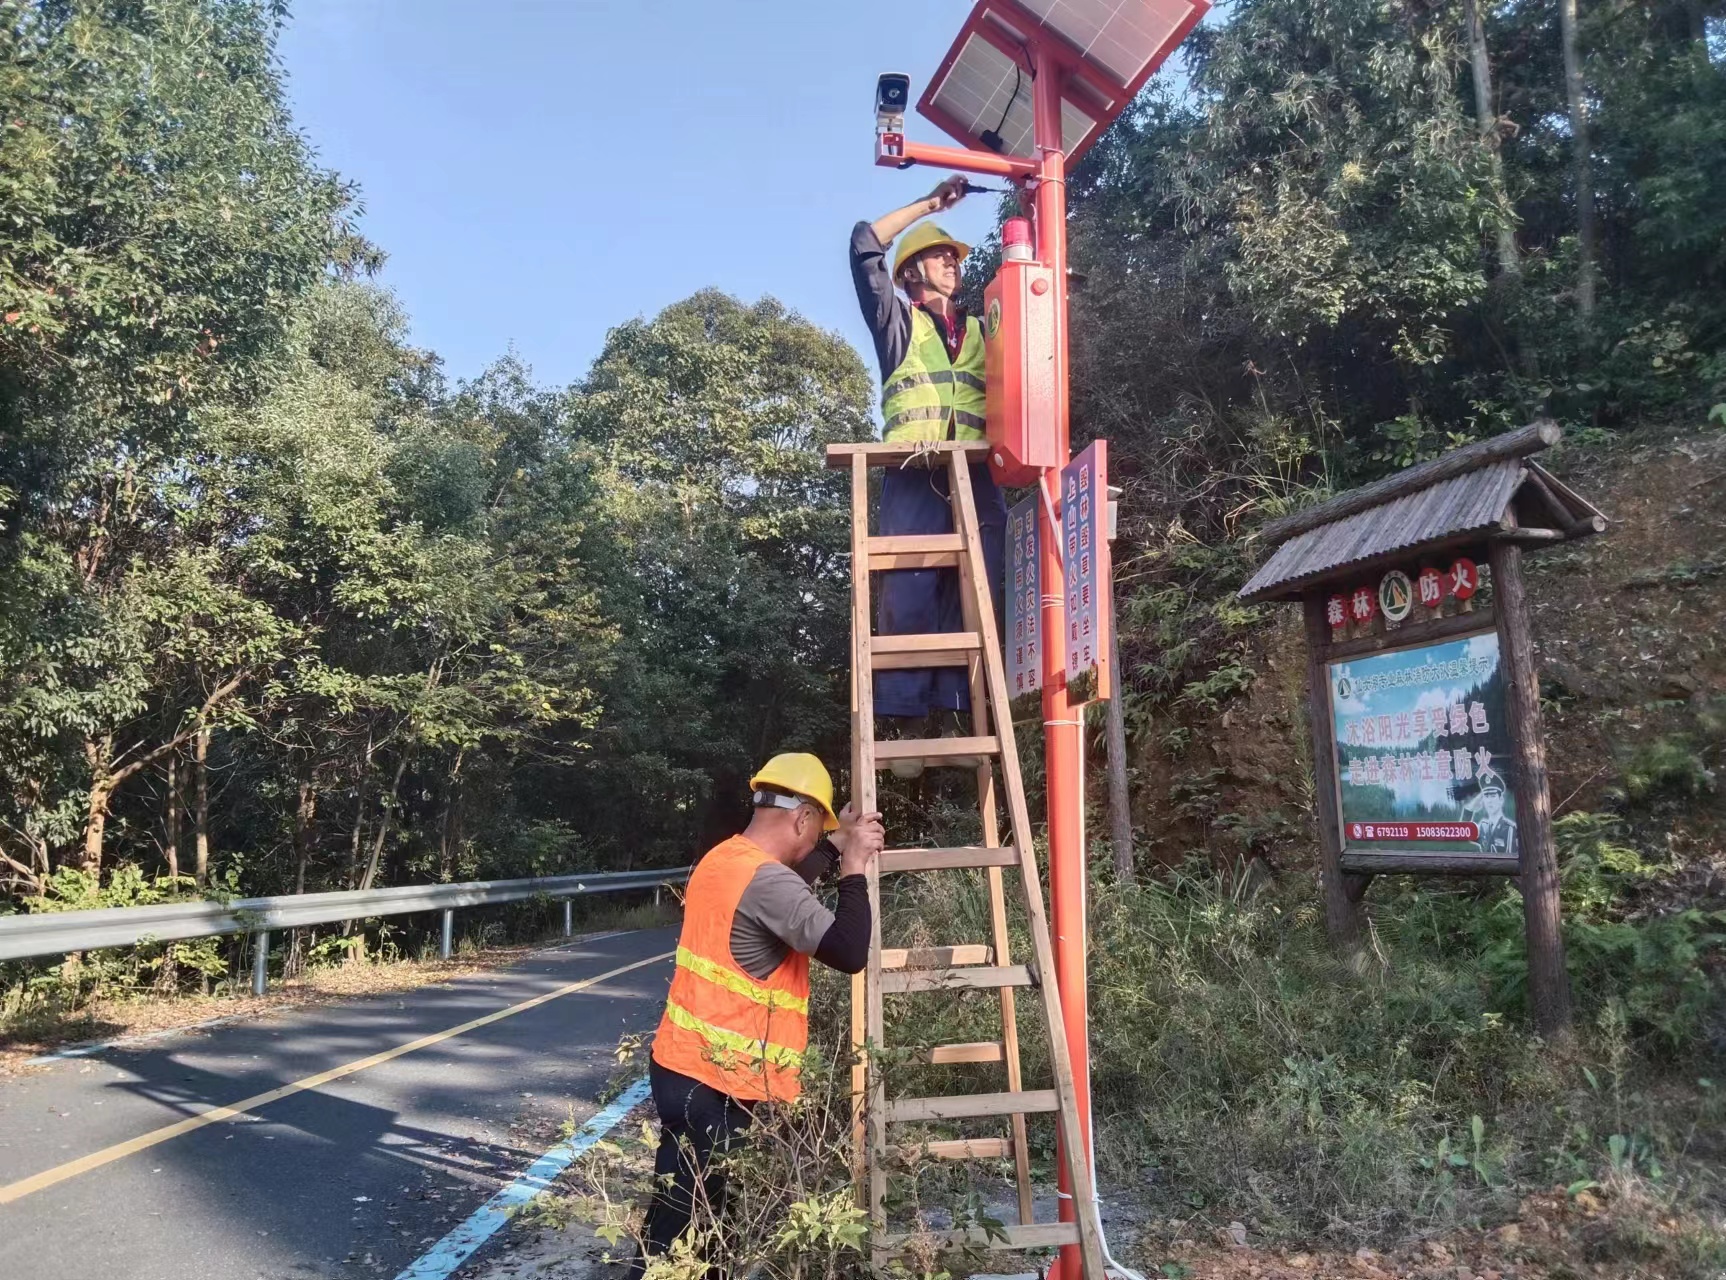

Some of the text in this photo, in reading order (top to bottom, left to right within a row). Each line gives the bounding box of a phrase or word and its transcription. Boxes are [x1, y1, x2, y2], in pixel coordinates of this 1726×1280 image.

[1015, 517, 1024, 691] 野外用火须谨慎
[1026, 508, 1036, 687] 引发火灾法不容
[1327, 591, 1370, 624] 森林
[1419, 563, 1472, 602] 防火
[1345, 701, 1490, 745] 沐浴阳光享受绿色
[1348, 746, 1496, 786] 走进森林注意防火
[1376, 826, 1471, 838] 6792119 15083622300
